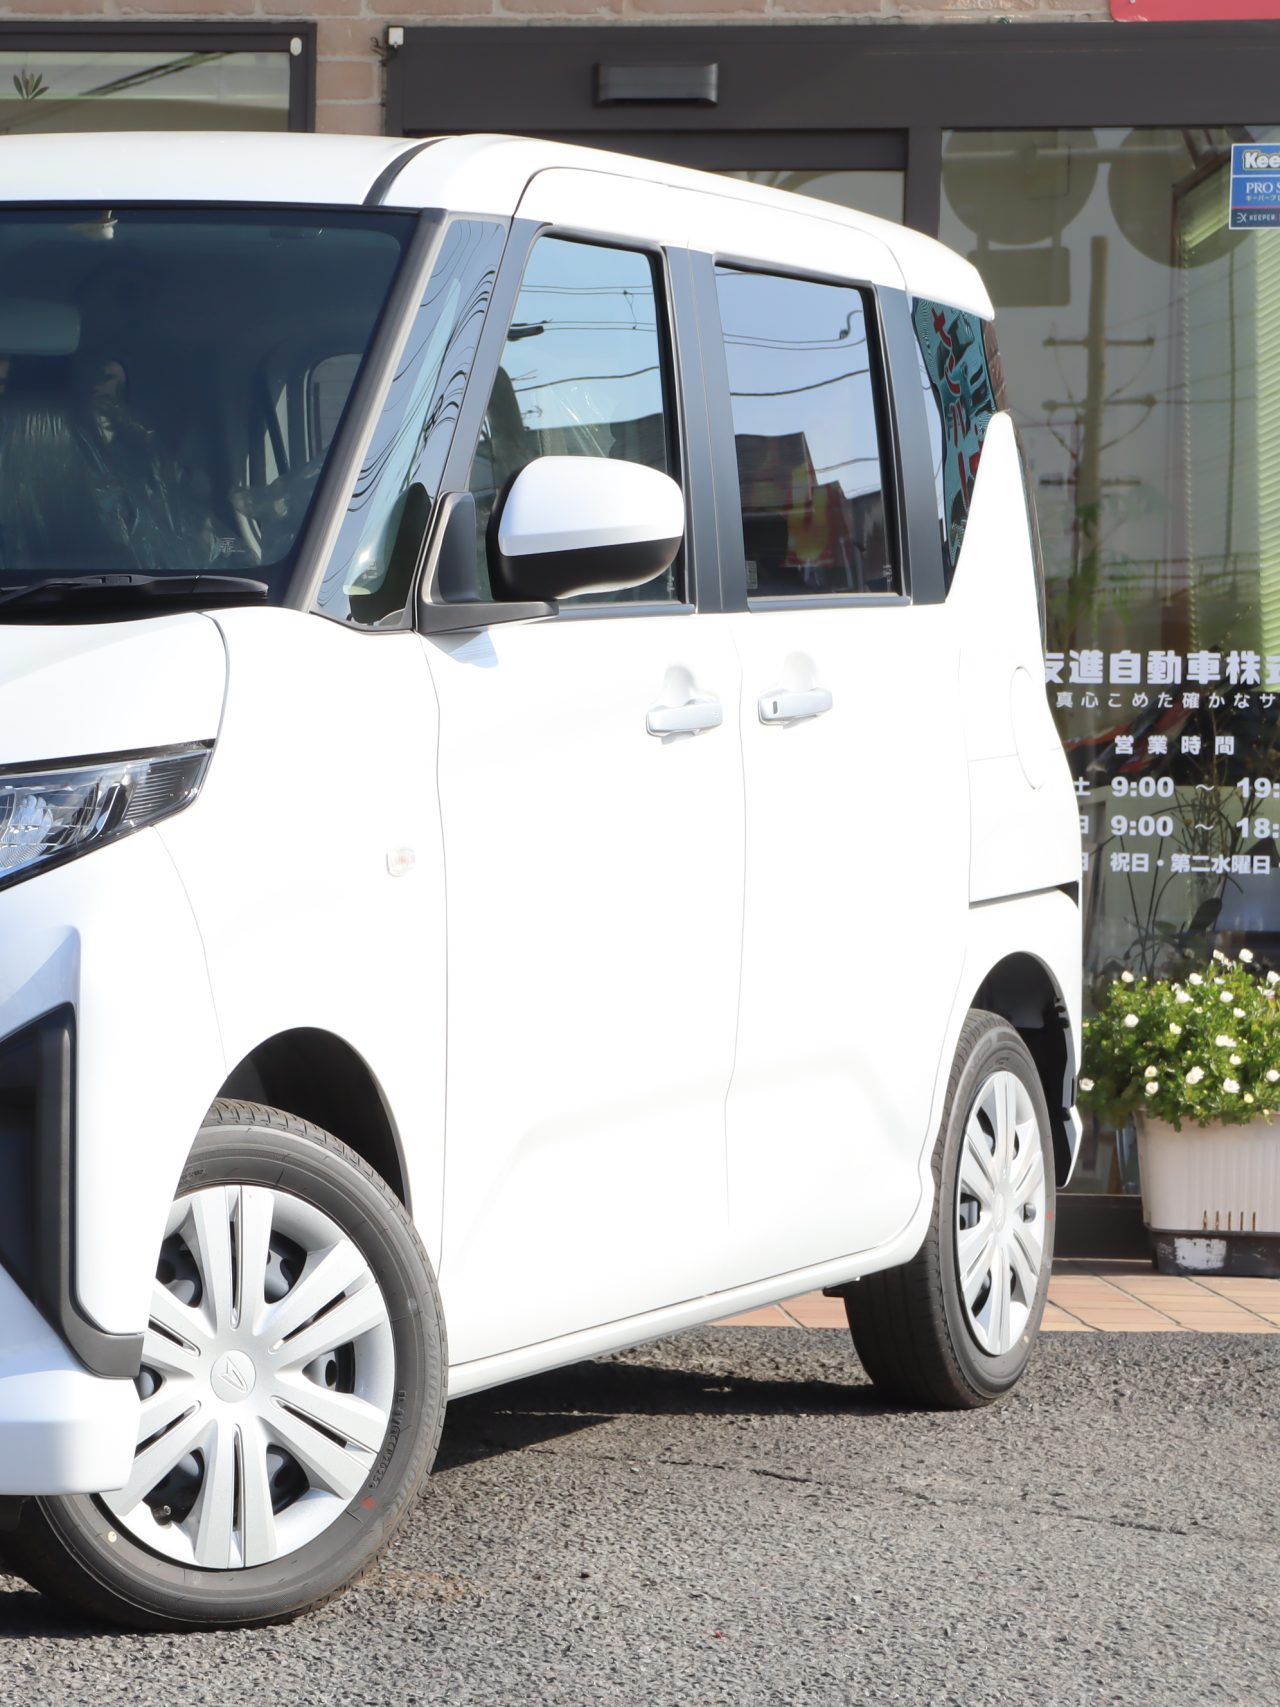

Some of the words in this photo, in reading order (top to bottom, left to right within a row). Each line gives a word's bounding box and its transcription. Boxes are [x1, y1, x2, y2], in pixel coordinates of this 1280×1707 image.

[1246, 182, 1274, 194] PRO
[1114, 735, 1235, 755] 営業時間
[1111, 776, 1174, 798] 9:00
[1110, 815, 1174, 837] 9:00
